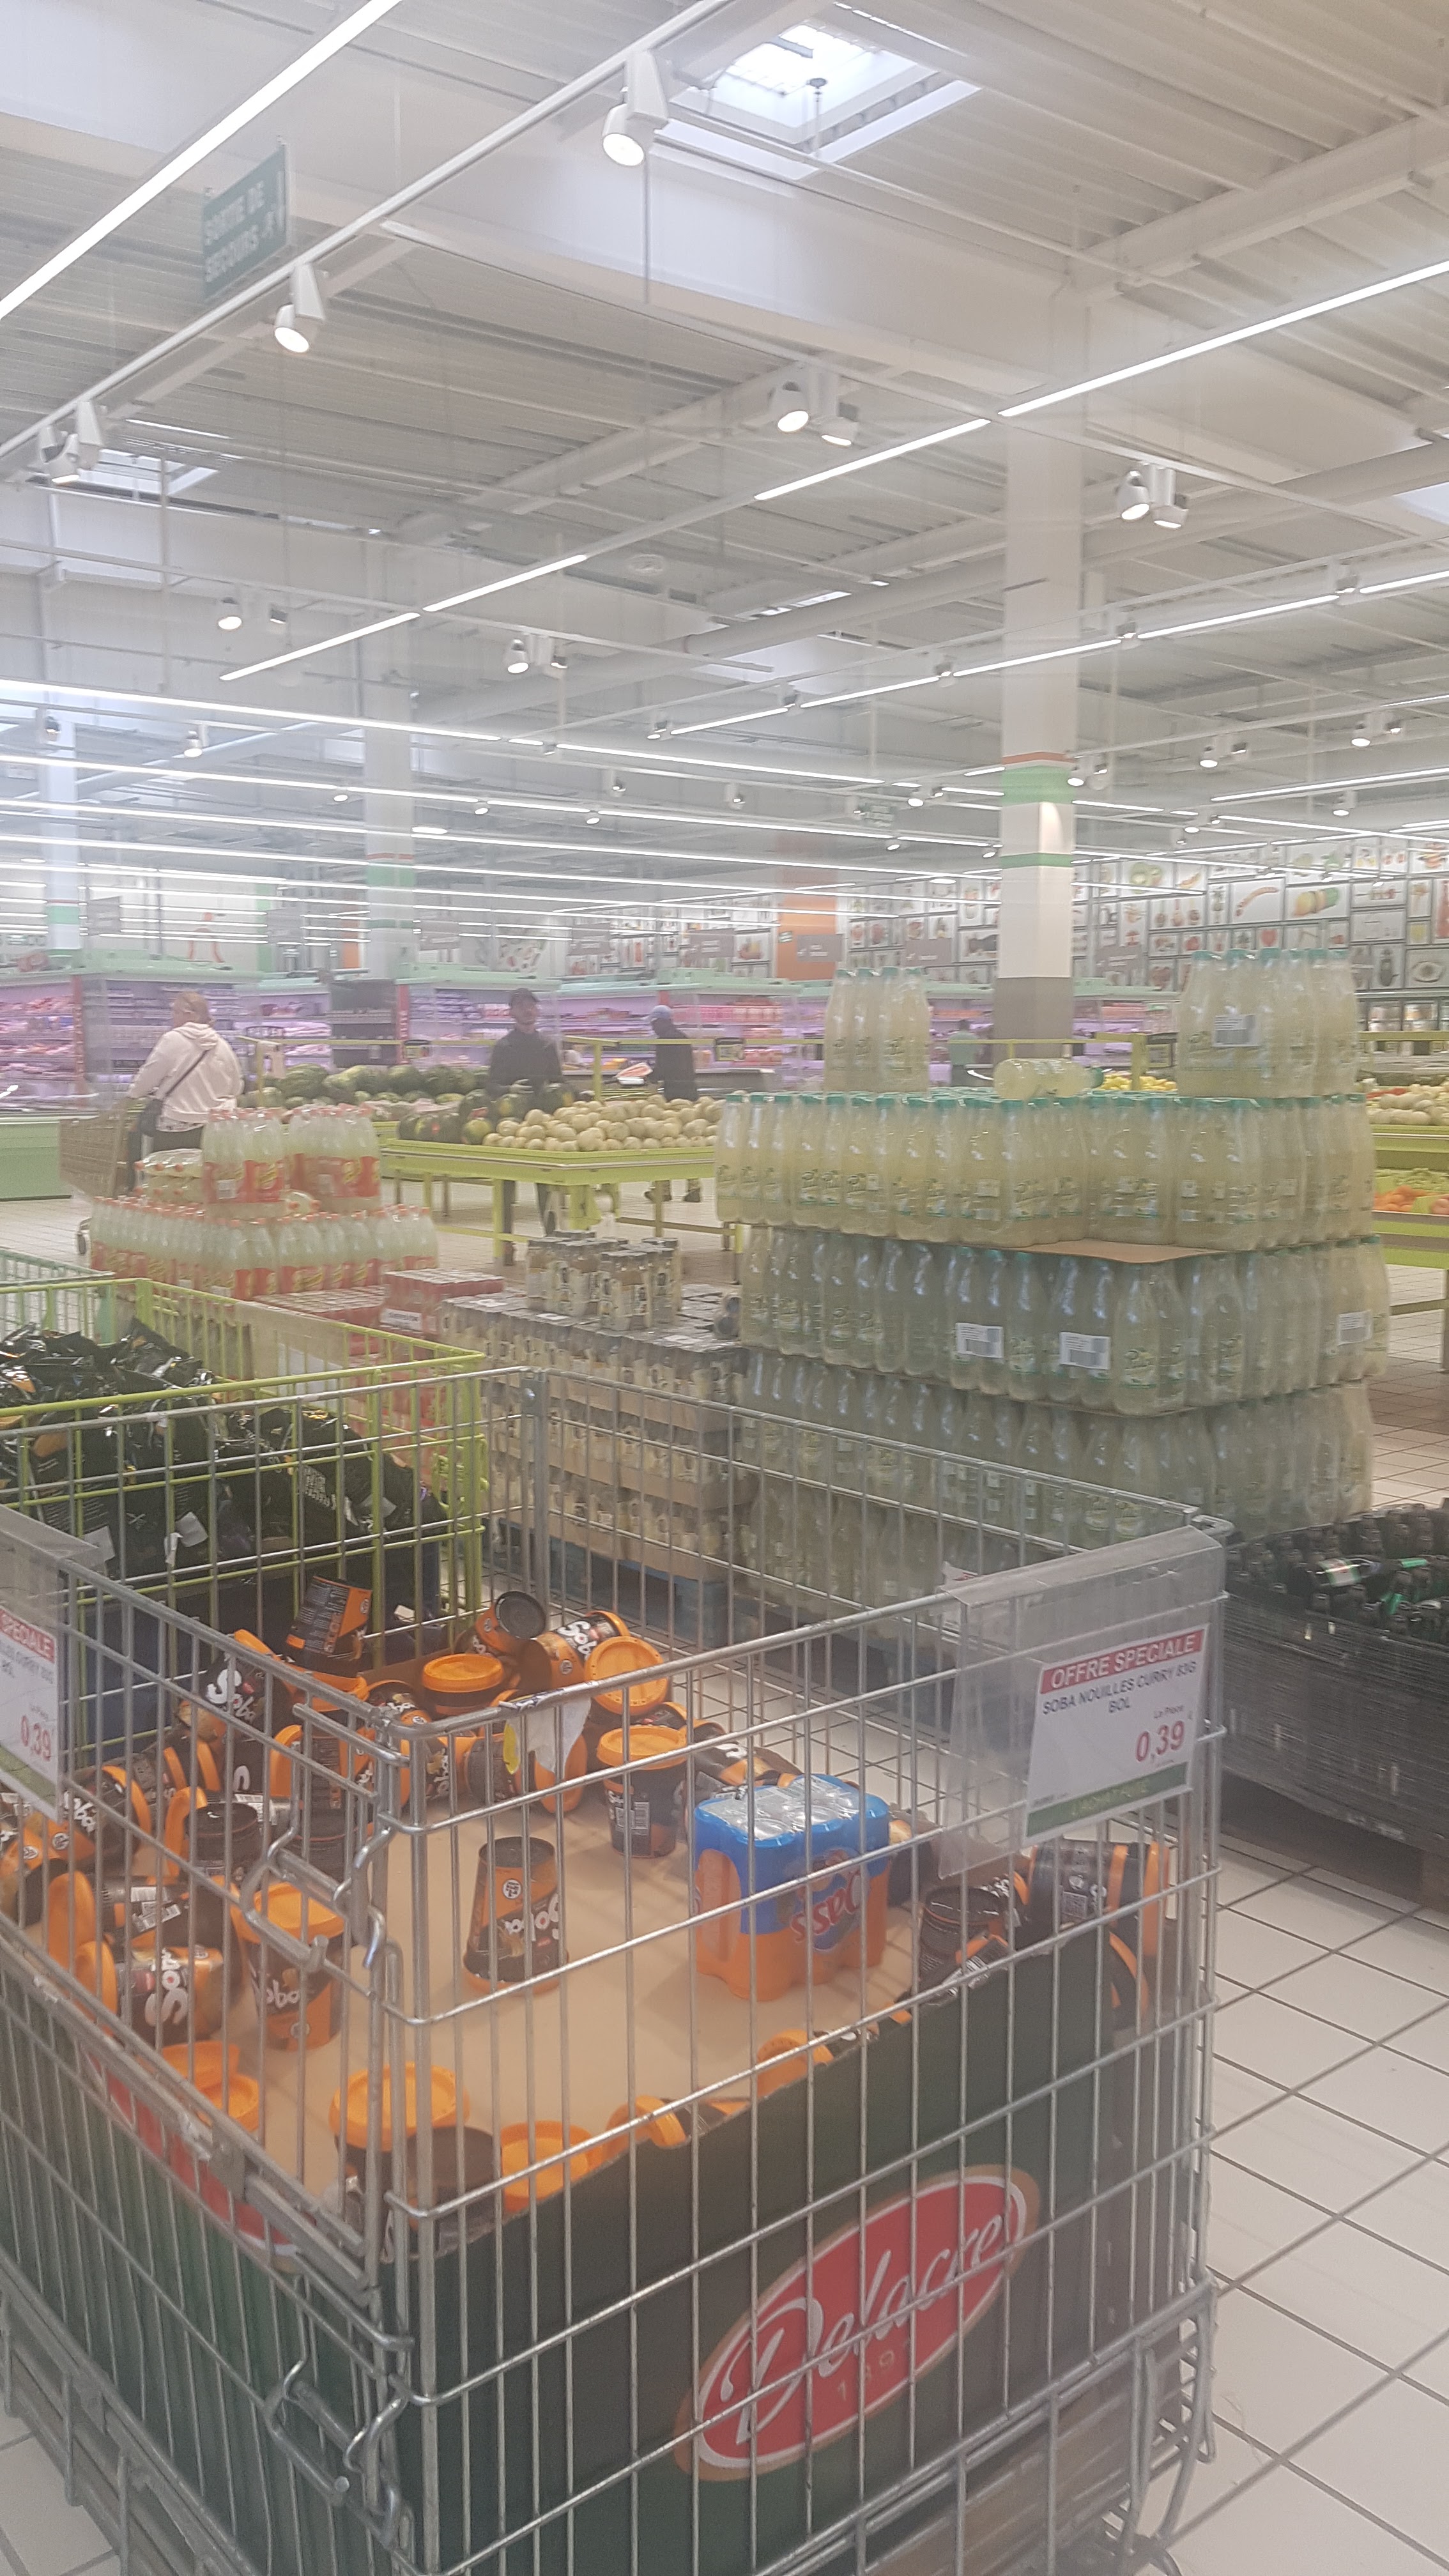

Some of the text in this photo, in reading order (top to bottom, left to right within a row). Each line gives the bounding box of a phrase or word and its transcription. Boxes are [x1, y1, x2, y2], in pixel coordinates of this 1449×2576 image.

[557, 1620, 598, 1661] Sob
[1050, 1634, 1197, 1689] OFFRE SPECIALE
[1043, 1695, 1077, 1715] SOBA
[1079, 1678, 1135, 1702] NOUILLES
[1137, 1667, 1174, 1688] CURRY
[1108, 1696, 1131, 1713] BOL
[1135, 1720, 1185, 1762] 0,39
[720, 2214, 1007, 2445] Delacre
